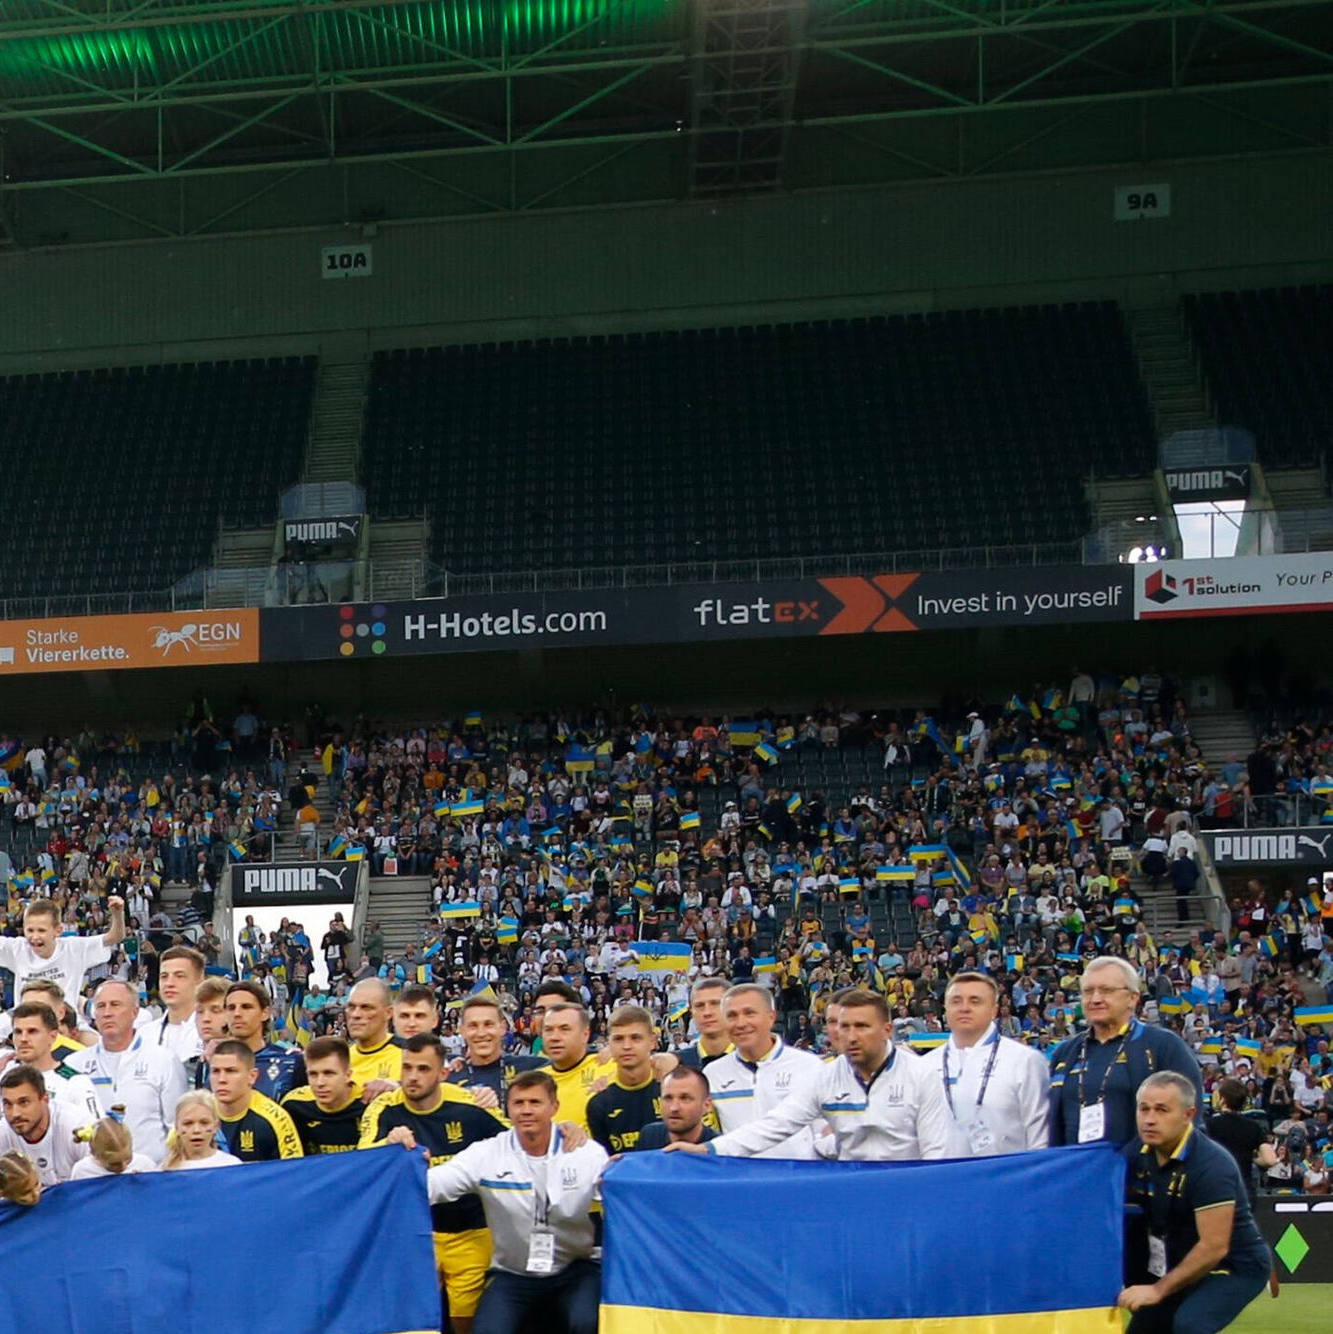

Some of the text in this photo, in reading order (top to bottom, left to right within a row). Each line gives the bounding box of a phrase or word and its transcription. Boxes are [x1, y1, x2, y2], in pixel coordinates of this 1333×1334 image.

[1126, 193, 1158, 210] 9A
[326, 252, 366, 270] 10A
[1166, 470, 1223, 491] PUMA
[286, 521, 337, 542] PUMA
[1196, 583, 1261, 596] solution
[1276, 573, 1316, 587] Your
[917, 586, 1121, 616] Invest in yourself
[198, 622, 240, 641] EGN
[404, 608, 607, 640] H-Hotels.com
[26, 629, 78, 645] Starke
[26, 645, 130, 663] Viererkette.
[1214, 835, 1296, 861] PUMA
[245, 869, 316, 894] PUMA
